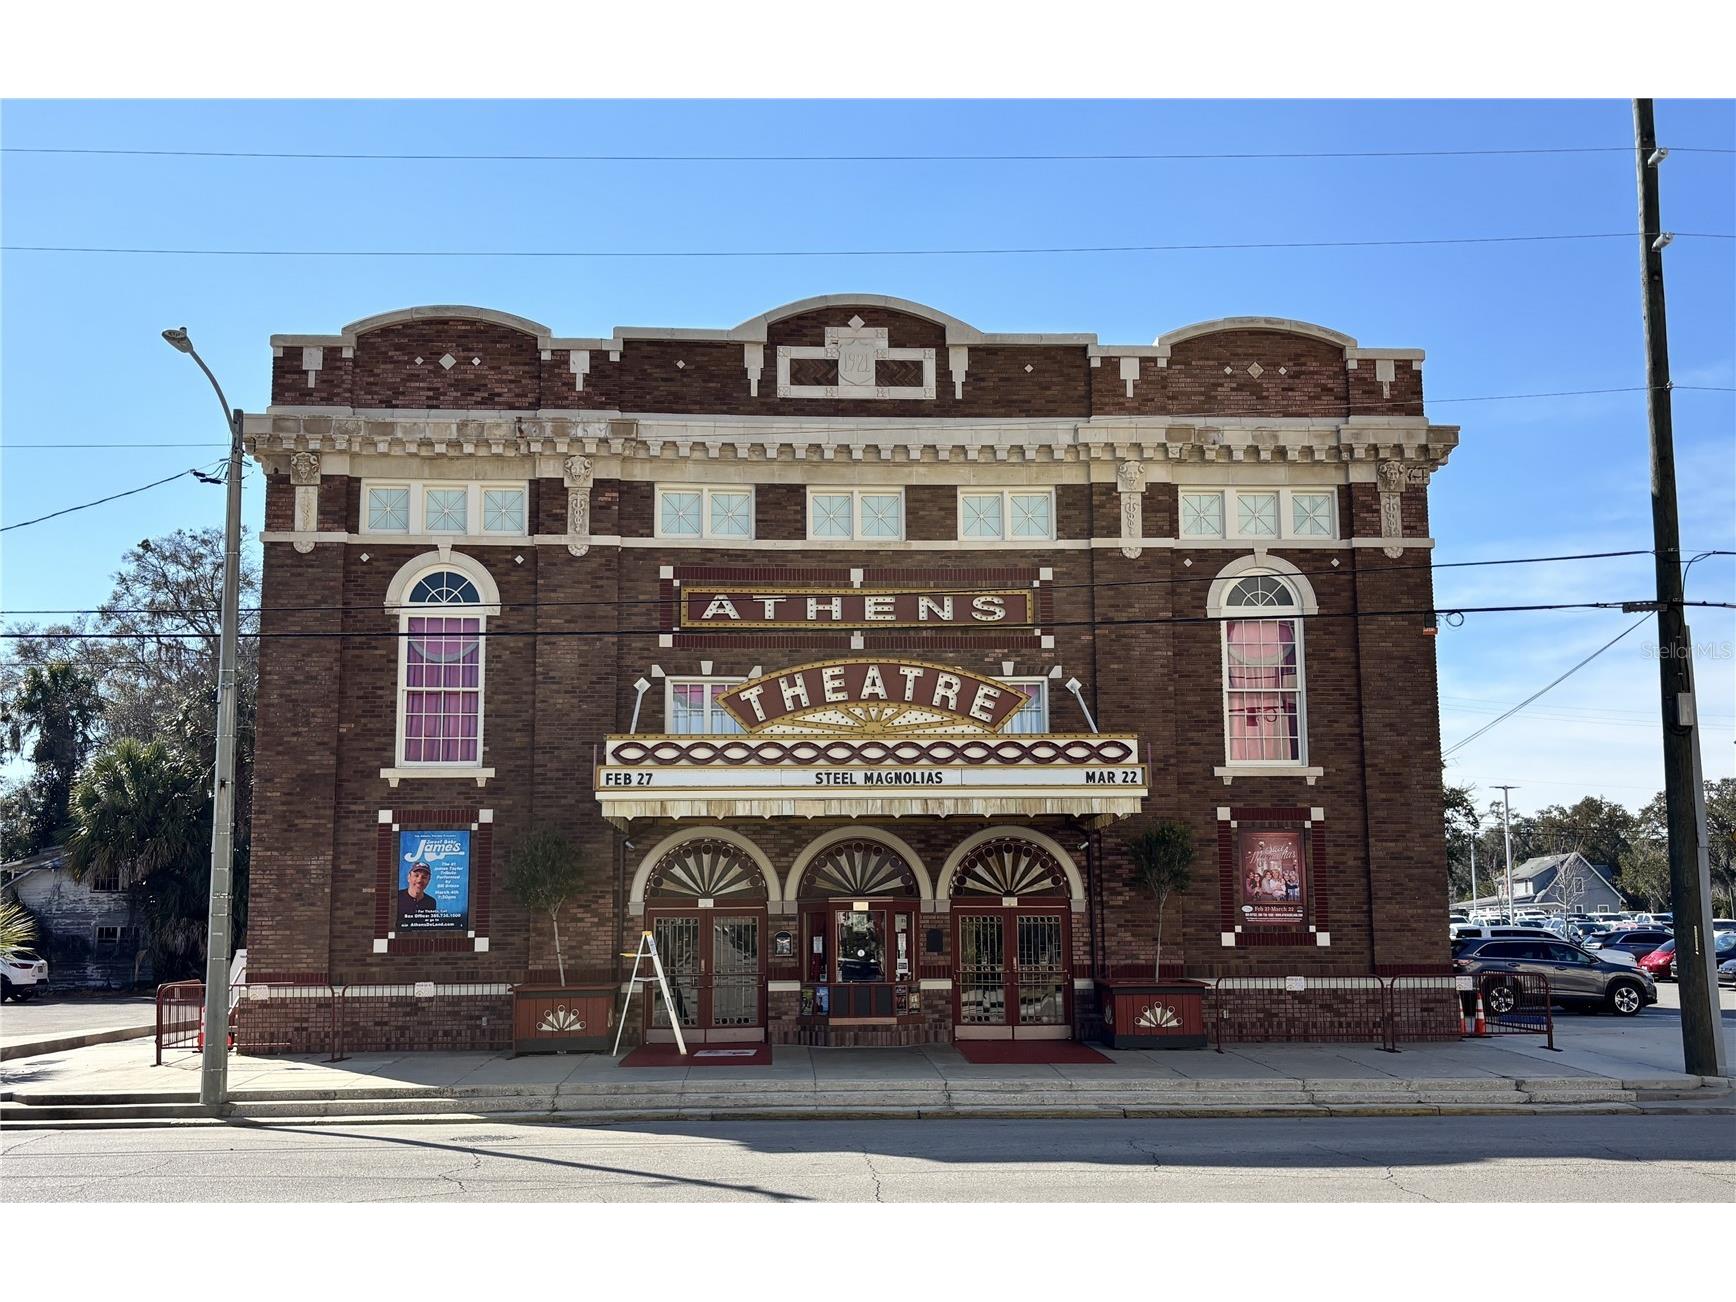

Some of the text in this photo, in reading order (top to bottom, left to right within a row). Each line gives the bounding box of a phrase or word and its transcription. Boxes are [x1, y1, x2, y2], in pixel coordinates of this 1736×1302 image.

[843, 351, 871, 373] 1921
[701, 594, 1007, 622] ATHENS
[739, 664, 999, 724] THEATRE
[605, 771, 654, 785] FEB 27
[815, 771, 943, 785] STEEL MAGNOLIAS
[1085, 771, 1138, 784] MAR 22
[404, 839, 461, 862] James
